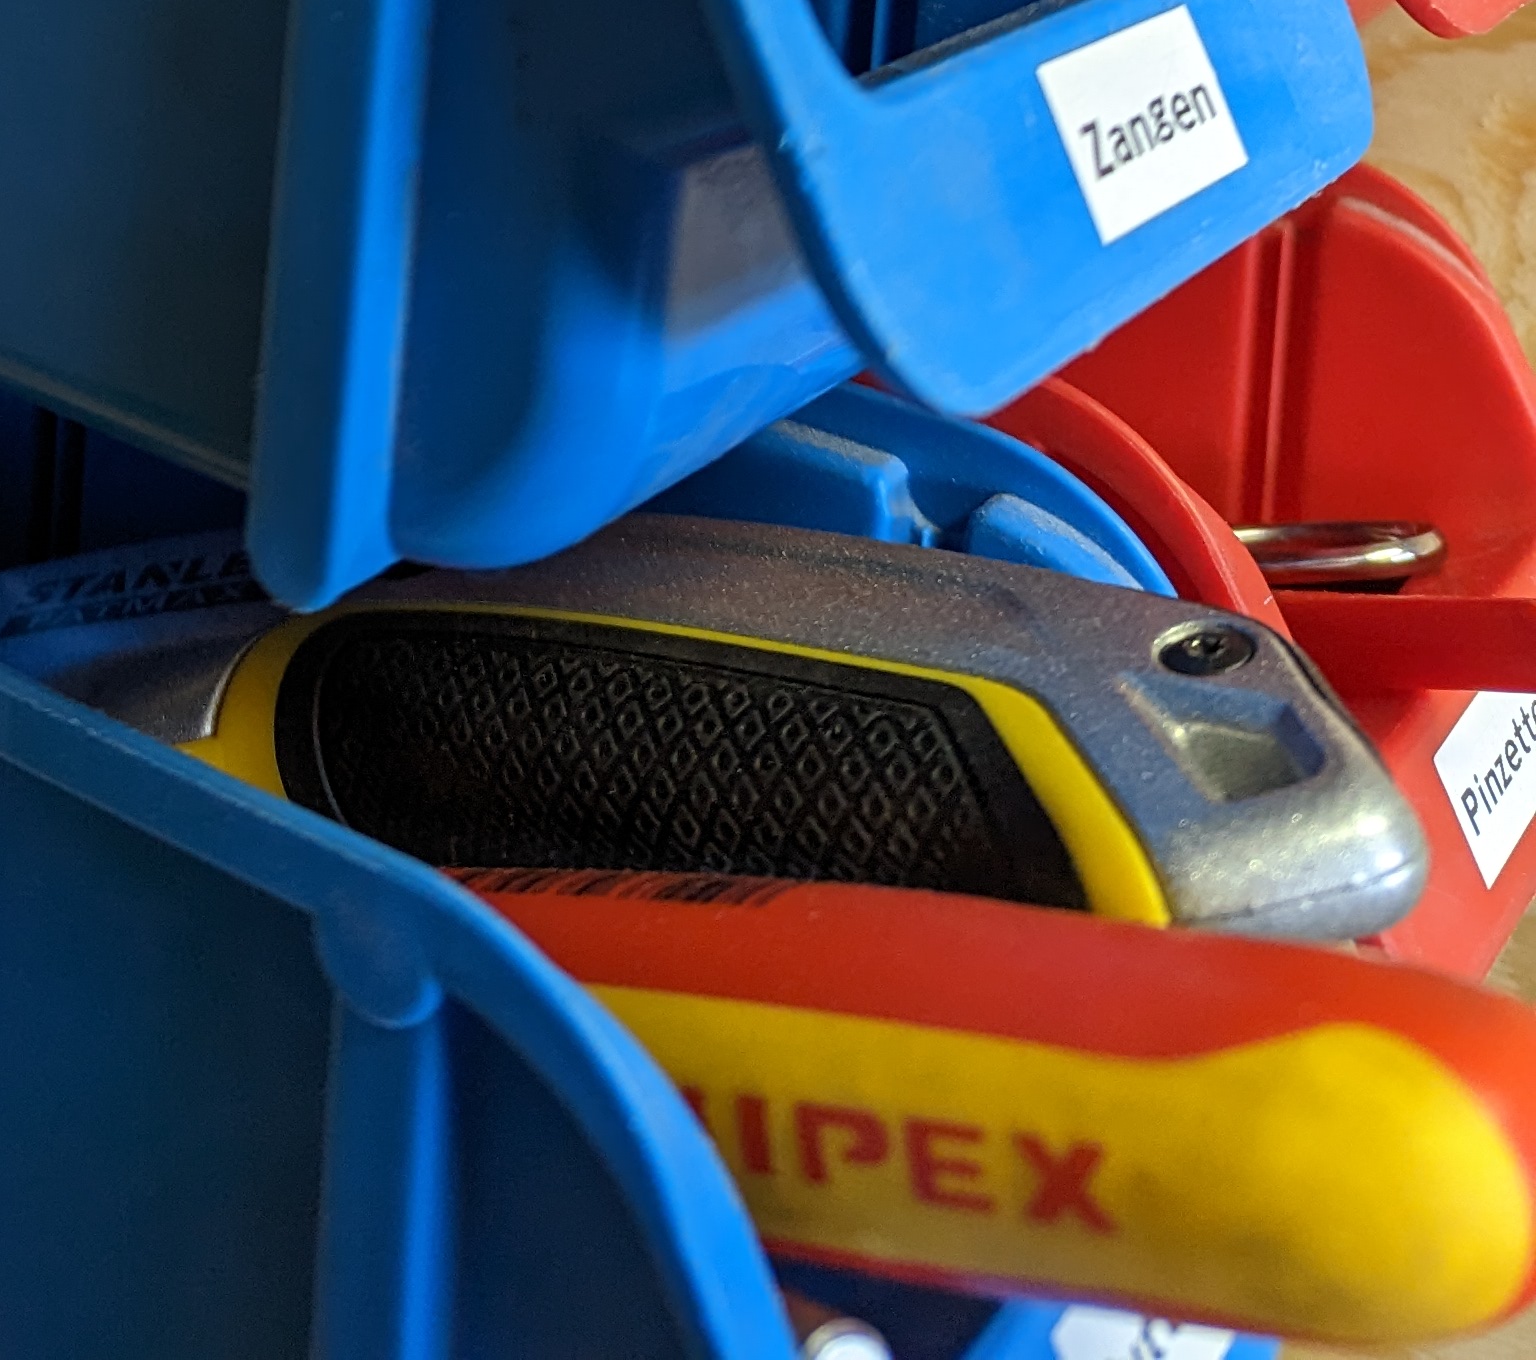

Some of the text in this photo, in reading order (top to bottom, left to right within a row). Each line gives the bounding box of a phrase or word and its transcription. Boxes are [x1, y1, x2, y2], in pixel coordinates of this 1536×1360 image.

[1077, 82, 1218, 181] Zangen
[26, 550, 250, 605] STANLE
[682, 1085, 1120, 1237] IPEX
